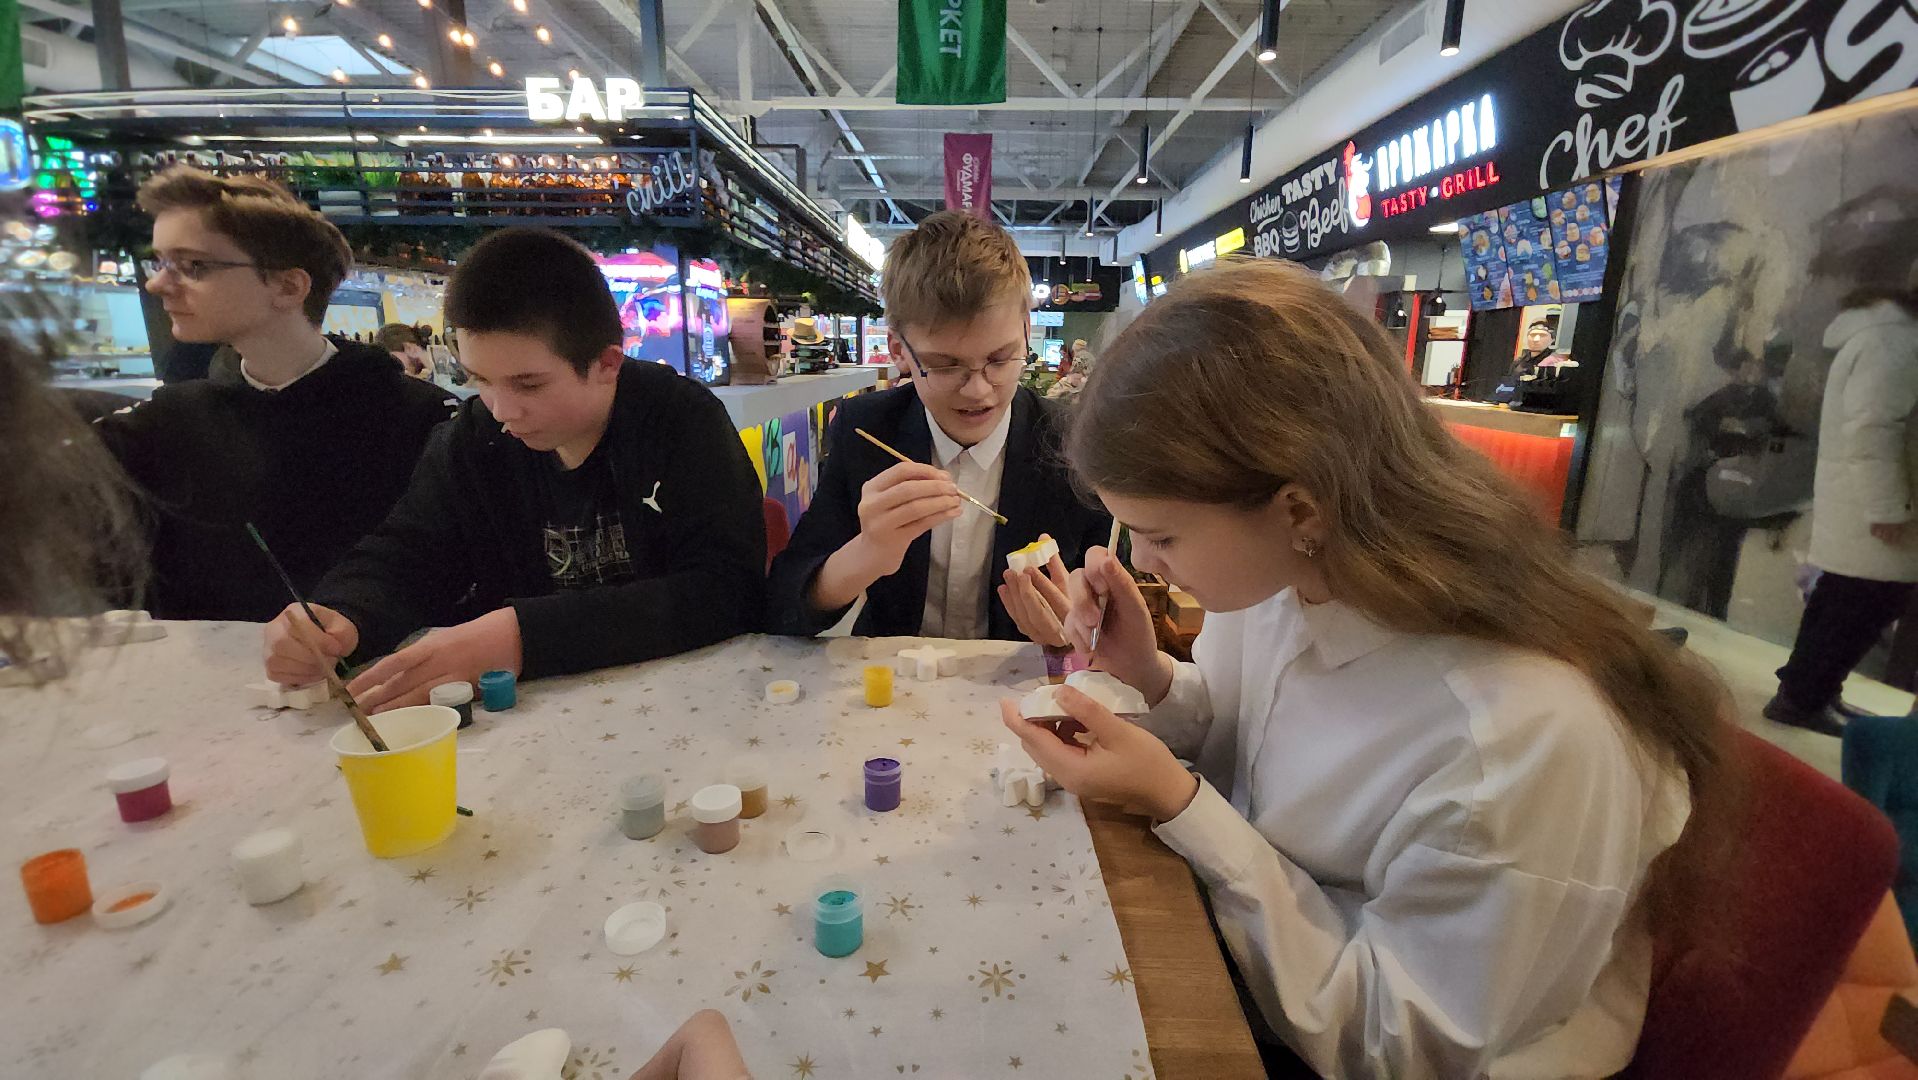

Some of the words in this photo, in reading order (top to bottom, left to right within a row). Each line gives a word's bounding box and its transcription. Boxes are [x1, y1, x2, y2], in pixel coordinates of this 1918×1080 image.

[525, 77, 643, 120] БАР
[1376, 94, 1496, 191] ПРОЖАРКА
[1282, 158, 1338, 205] TASTY
[1381, 185, 1428, 218] TASTY
[1440, 161, 1500, 199] GRILL
[1250, 193, 1284, 231] Chicken
[1300, 177, 1349, 249] Beef
[1254, 228, 1279, 257] BBQ
